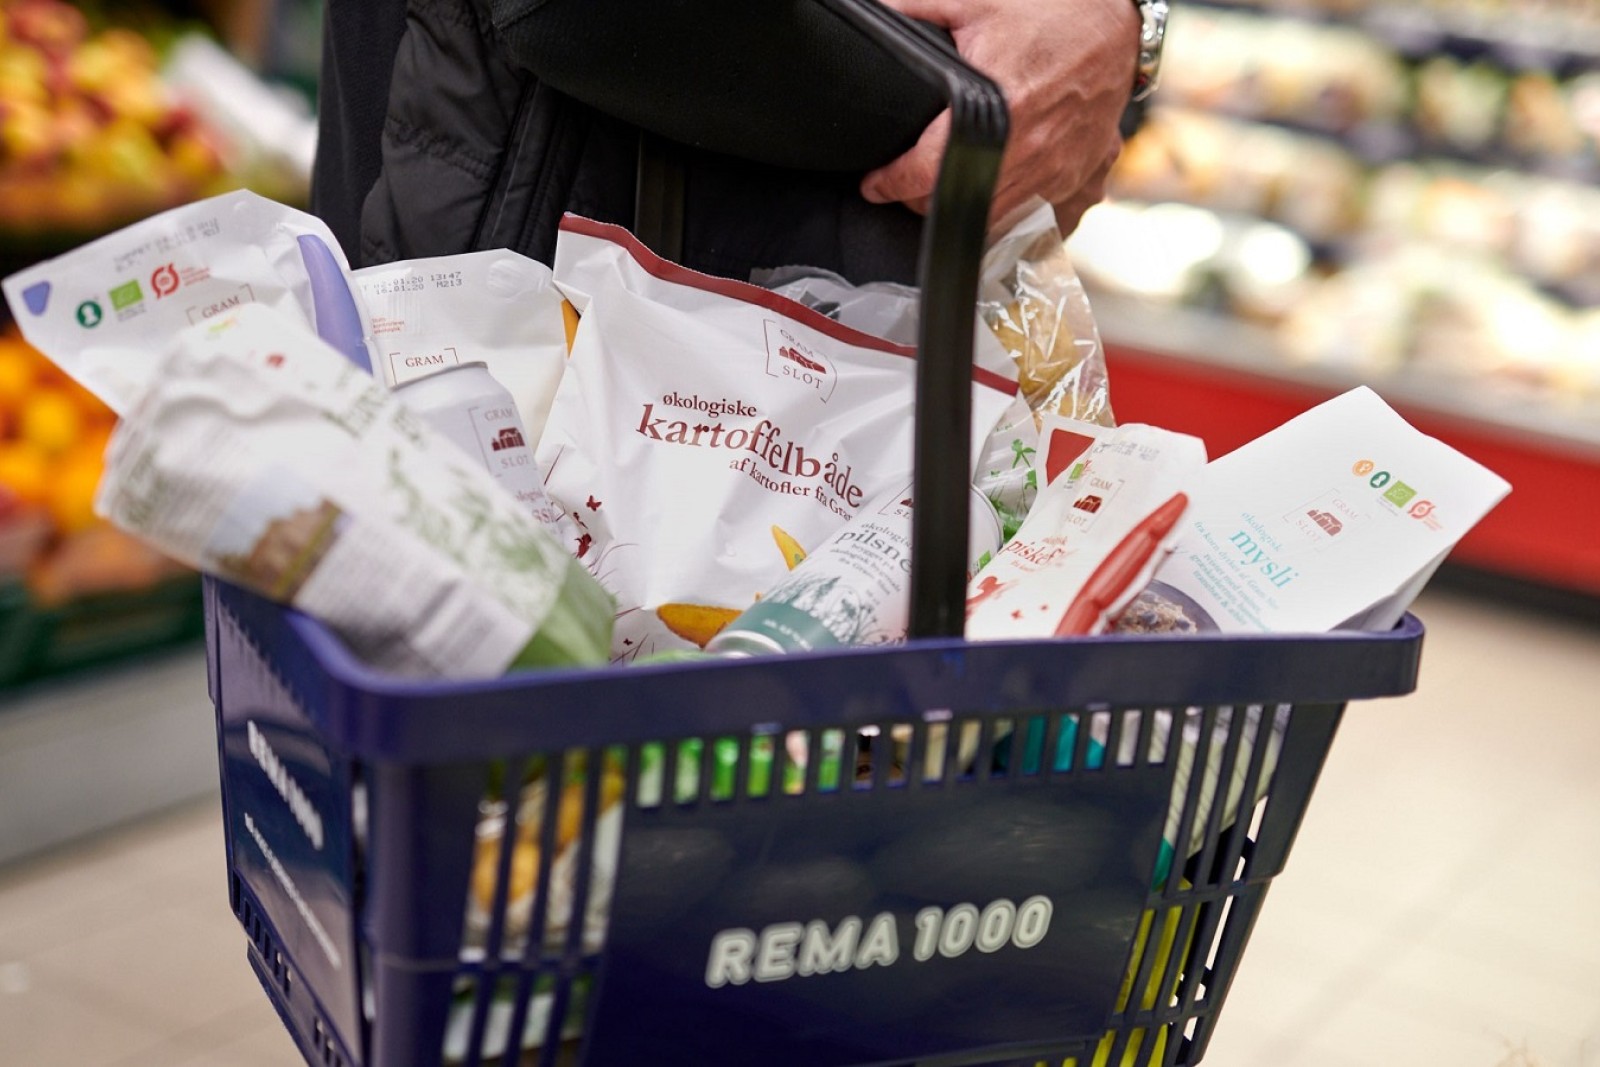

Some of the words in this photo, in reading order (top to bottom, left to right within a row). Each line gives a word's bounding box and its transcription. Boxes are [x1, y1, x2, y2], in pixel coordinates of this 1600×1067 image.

[430, 271, 461, 282] 13:47
[436, 278, 463, 288] M213
[201, 295, 240, 319] GRAM
[780, 328, 814, 357] GRAM
[405, 354, 444, 369] GRAM
[782, 364, 824, 389] SLOT
[484, 407, 515, 422] GRAM
[663, 392, 757, 418] økologiske
[500, 455, 530, 469] SLOT
[635, 403, 864, 508] kartoffelbåde
[729, 458, 750, 472] af
[749, 462, 811, 496] kartofler
[815, 486, 828, 507] fra
[1089, 476, 1113, 490] GRAM
[1331, 498, 1359, 521] GRAM
[861, 522, 913, 549] økologis
[1241, 511, 1282, 552] økologisk
[1296, 519, 1323, 542] SLOT
[834, 530, 913, 574] pilsne
[1228, 530, 1299, 588] mysli
[705, 911, 899, 989] REMA
[914, 894, 1053, 962] 1000
